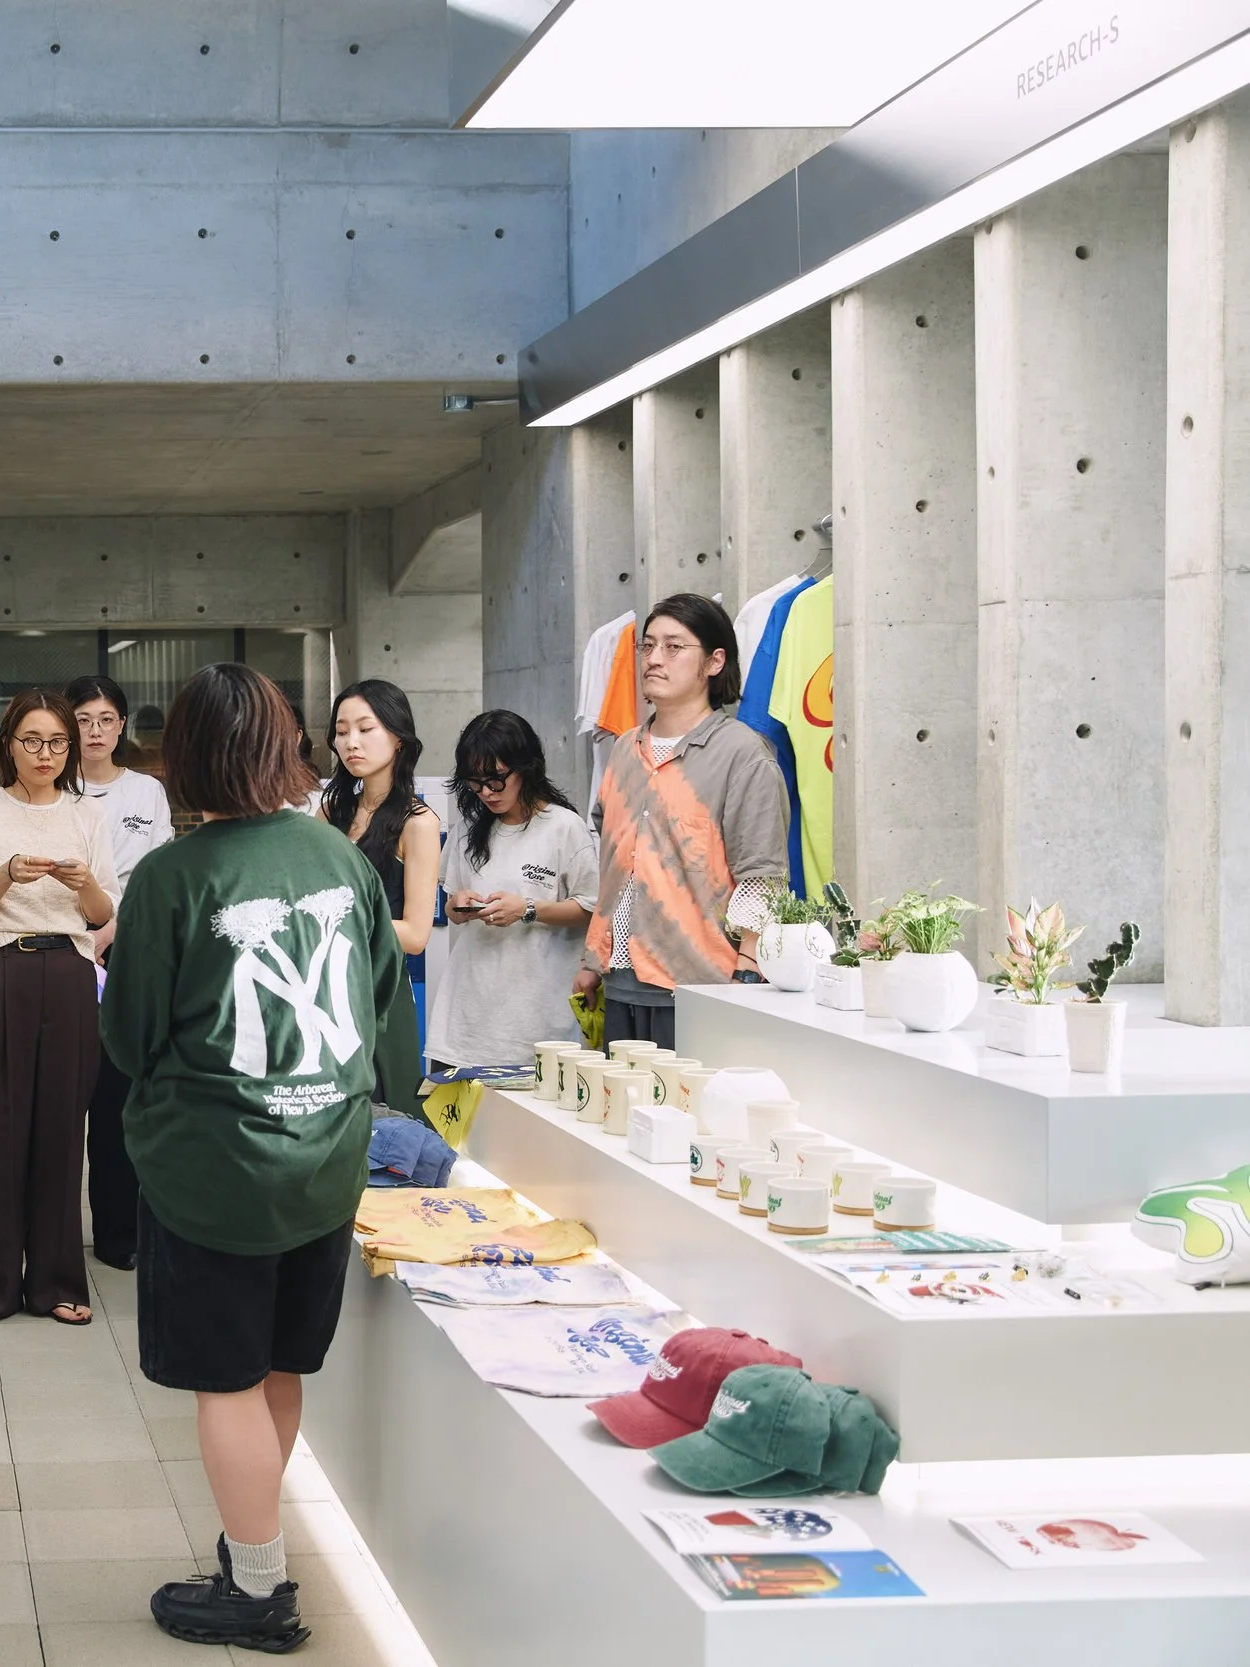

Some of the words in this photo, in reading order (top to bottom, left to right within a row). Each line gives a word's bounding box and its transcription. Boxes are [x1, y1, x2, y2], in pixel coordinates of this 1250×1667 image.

[1016, 15, 1120, 99] RESEARCH-S
[273, 1086, 292, 1096] The
[294, 1082, 337, 1095] Arboreal
[311, 1092, 347, 1103] Society
[268, 1104, 282, 1115] of
[283, 1104, 304, 1116] New
